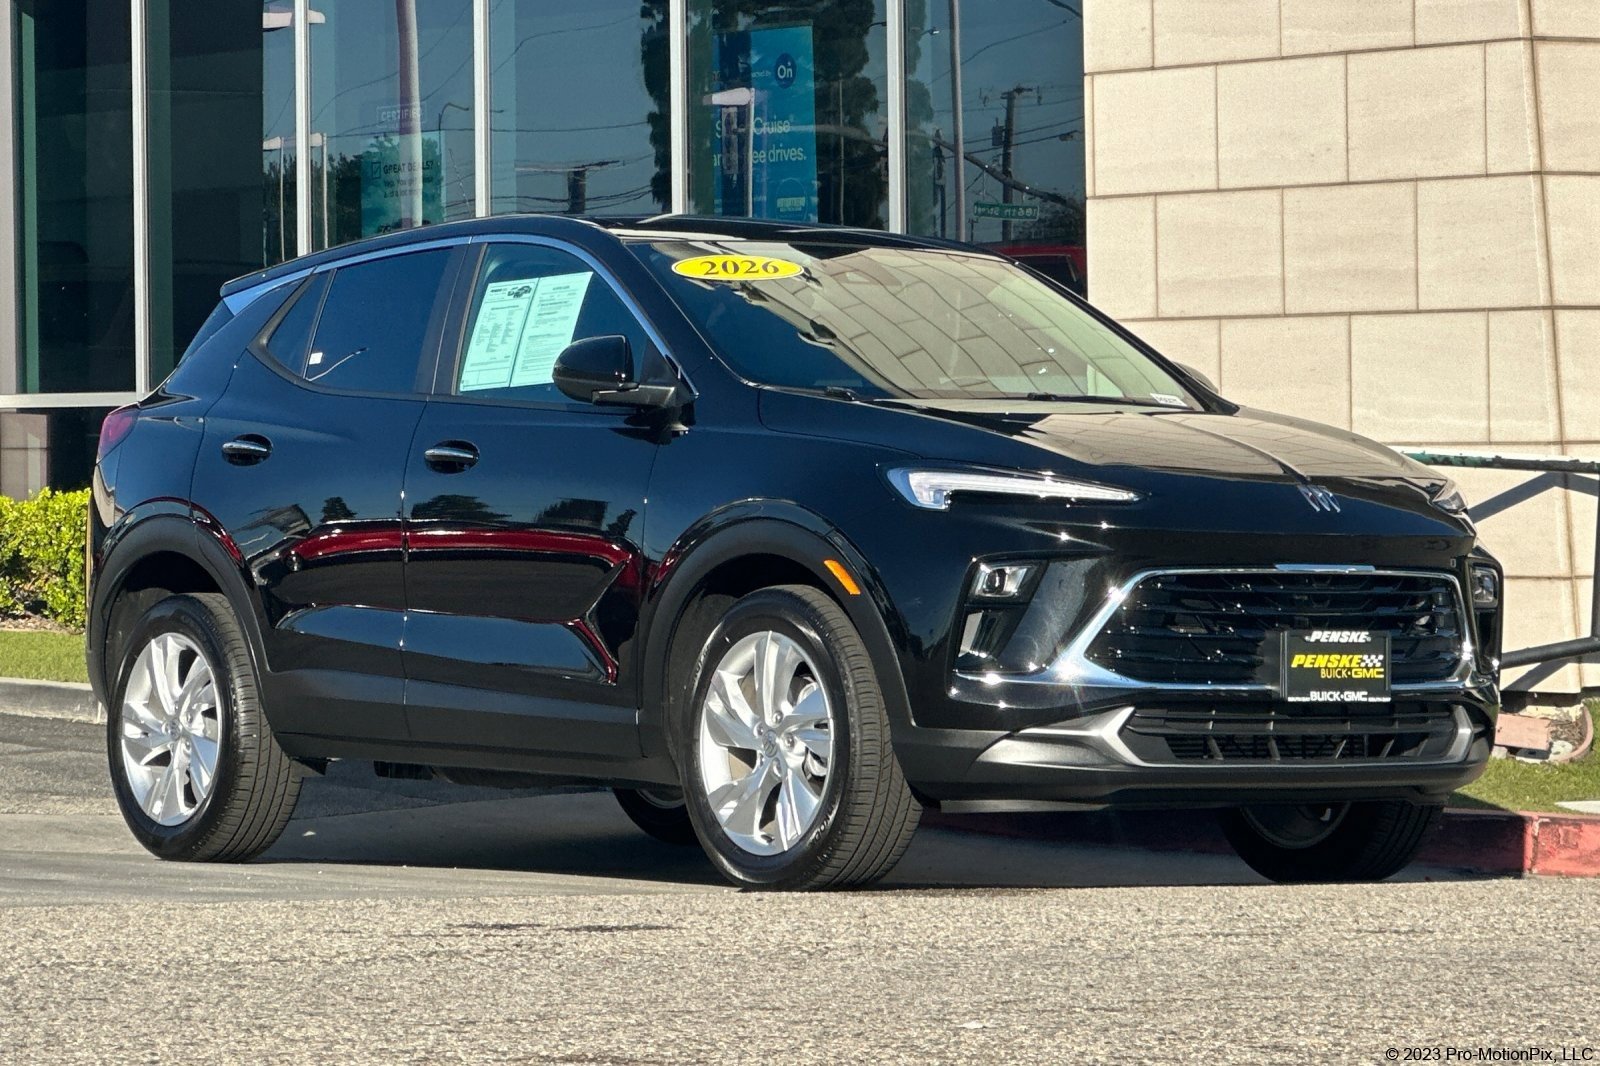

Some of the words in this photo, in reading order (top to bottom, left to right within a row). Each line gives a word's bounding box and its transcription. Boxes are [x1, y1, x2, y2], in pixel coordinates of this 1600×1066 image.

[777, 64, 793, 79] On
[753, 115, 791, 134] Cruise
[768, 143, 807, 162] drives.
[700, 260, 779, 275] 2026
[1310, 631, 1369, 643] PENSKE
[1291, 654, 1362, 668] PENSKE
